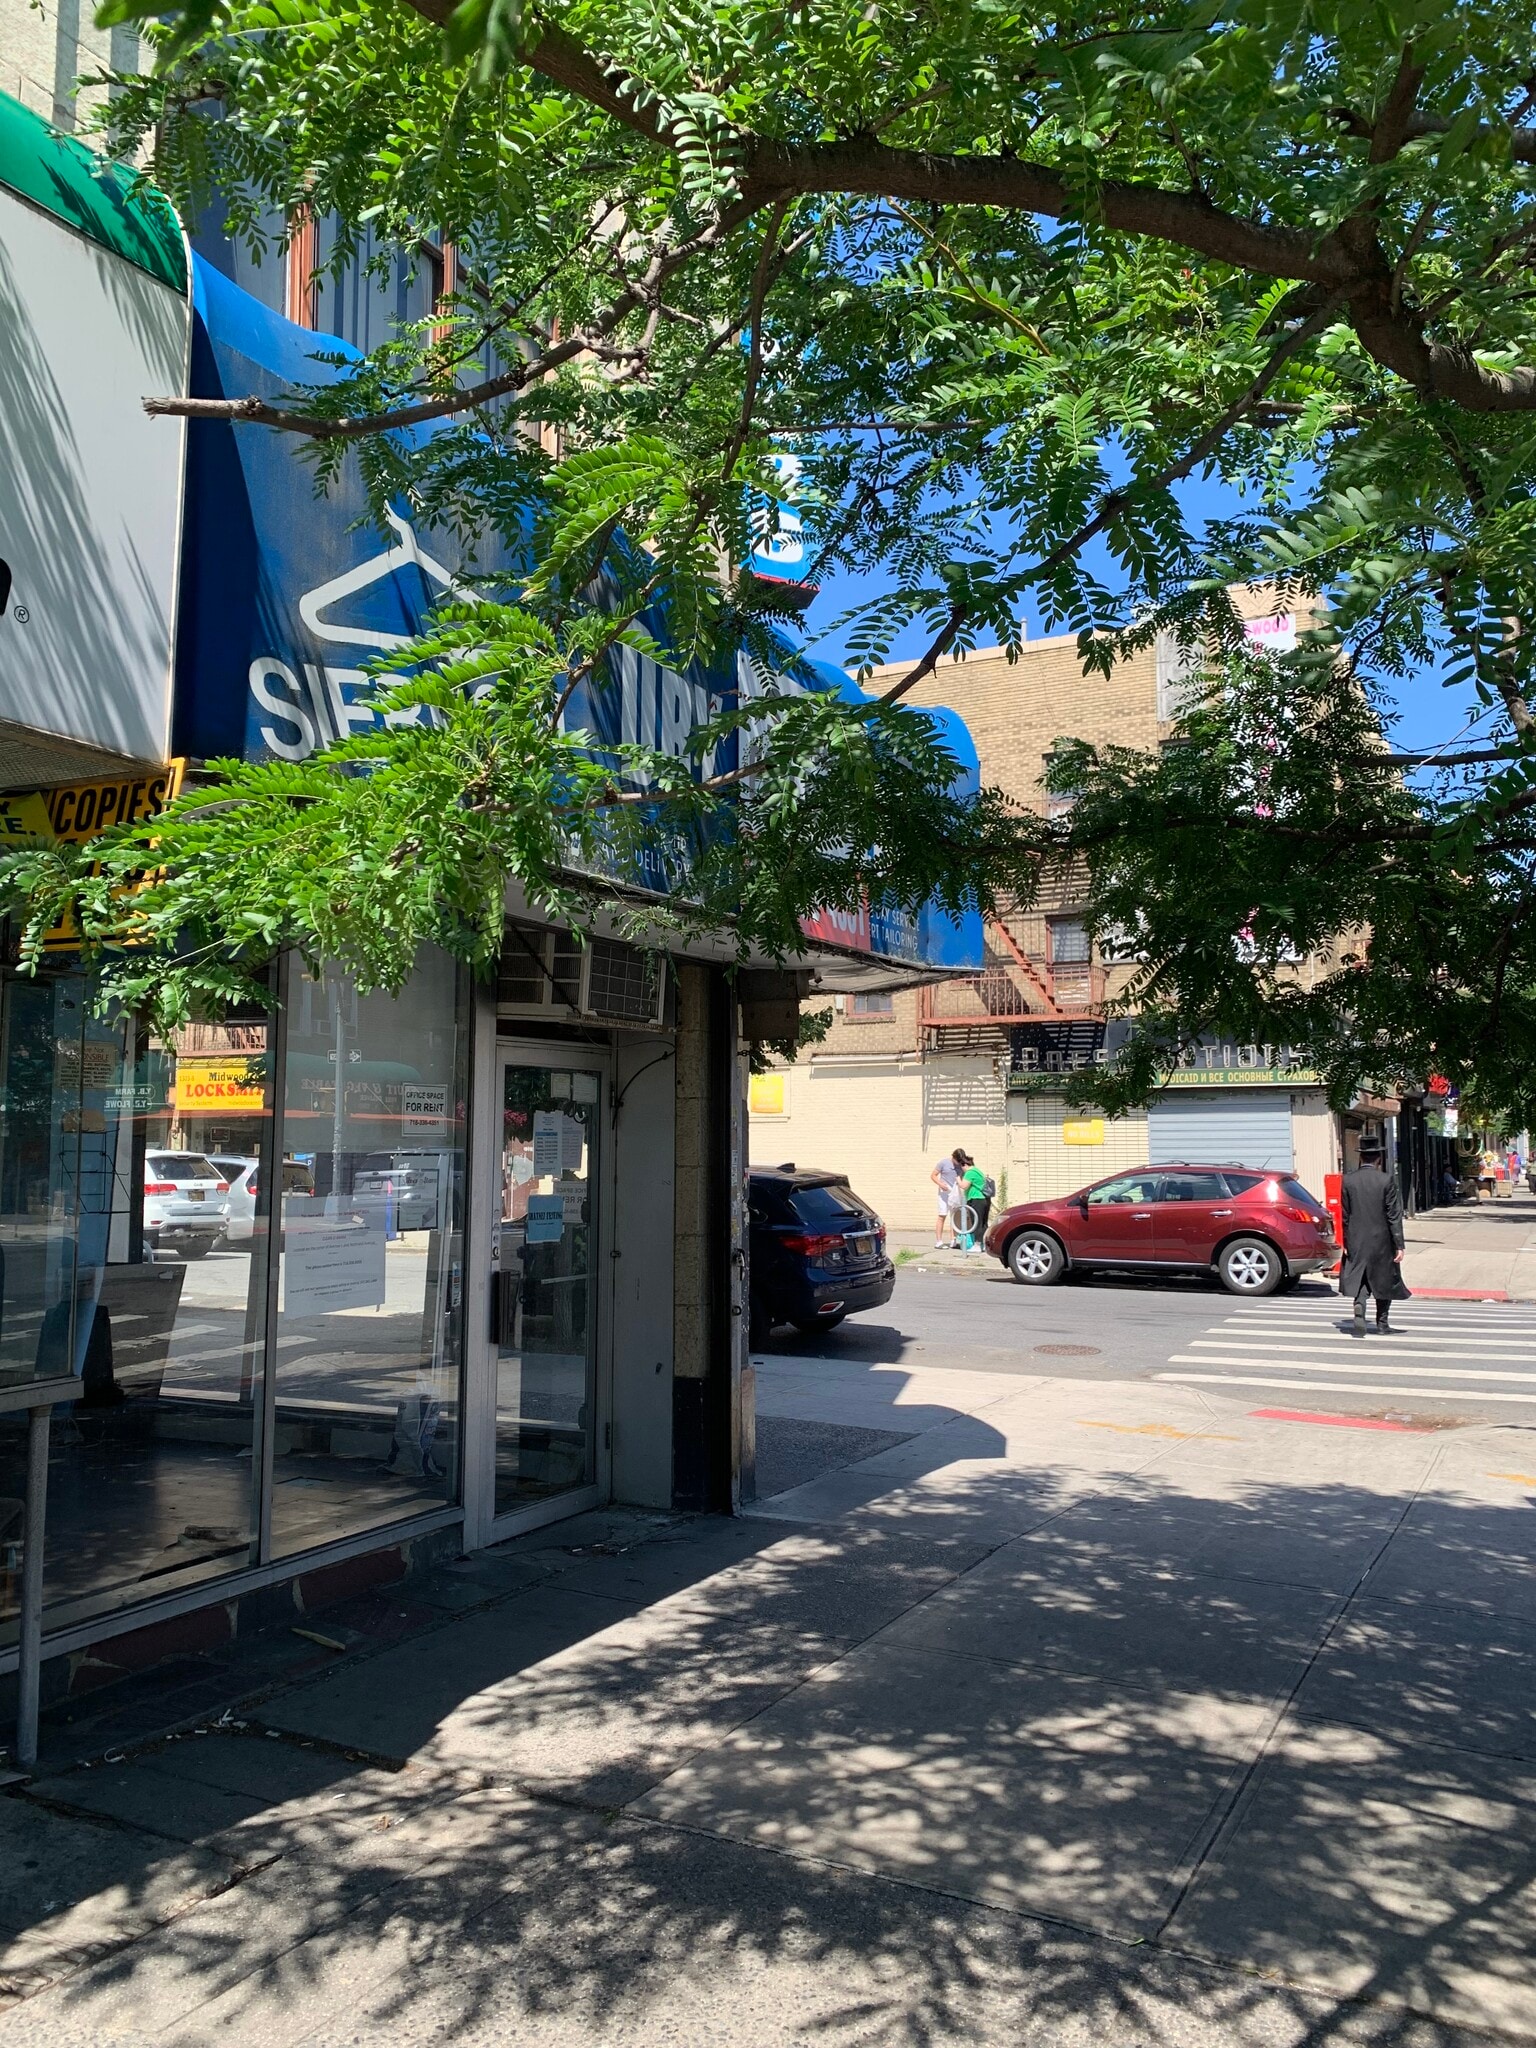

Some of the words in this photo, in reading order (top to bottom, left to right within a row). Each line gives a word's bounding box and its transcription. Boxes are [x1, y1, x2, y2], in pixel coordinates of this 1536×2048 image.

[54, 779, 166, 834] COPIES
[881, 926, 918, 951] TAILORING
[1228, 1071, 1273, 1082] ОСНОВНЫЕ
[1277, 1070, 1319, 1081] СТРАХОВ
[405, 1102, 422, 1112] FOR
[424, 1103, 444, 1112] RENT
